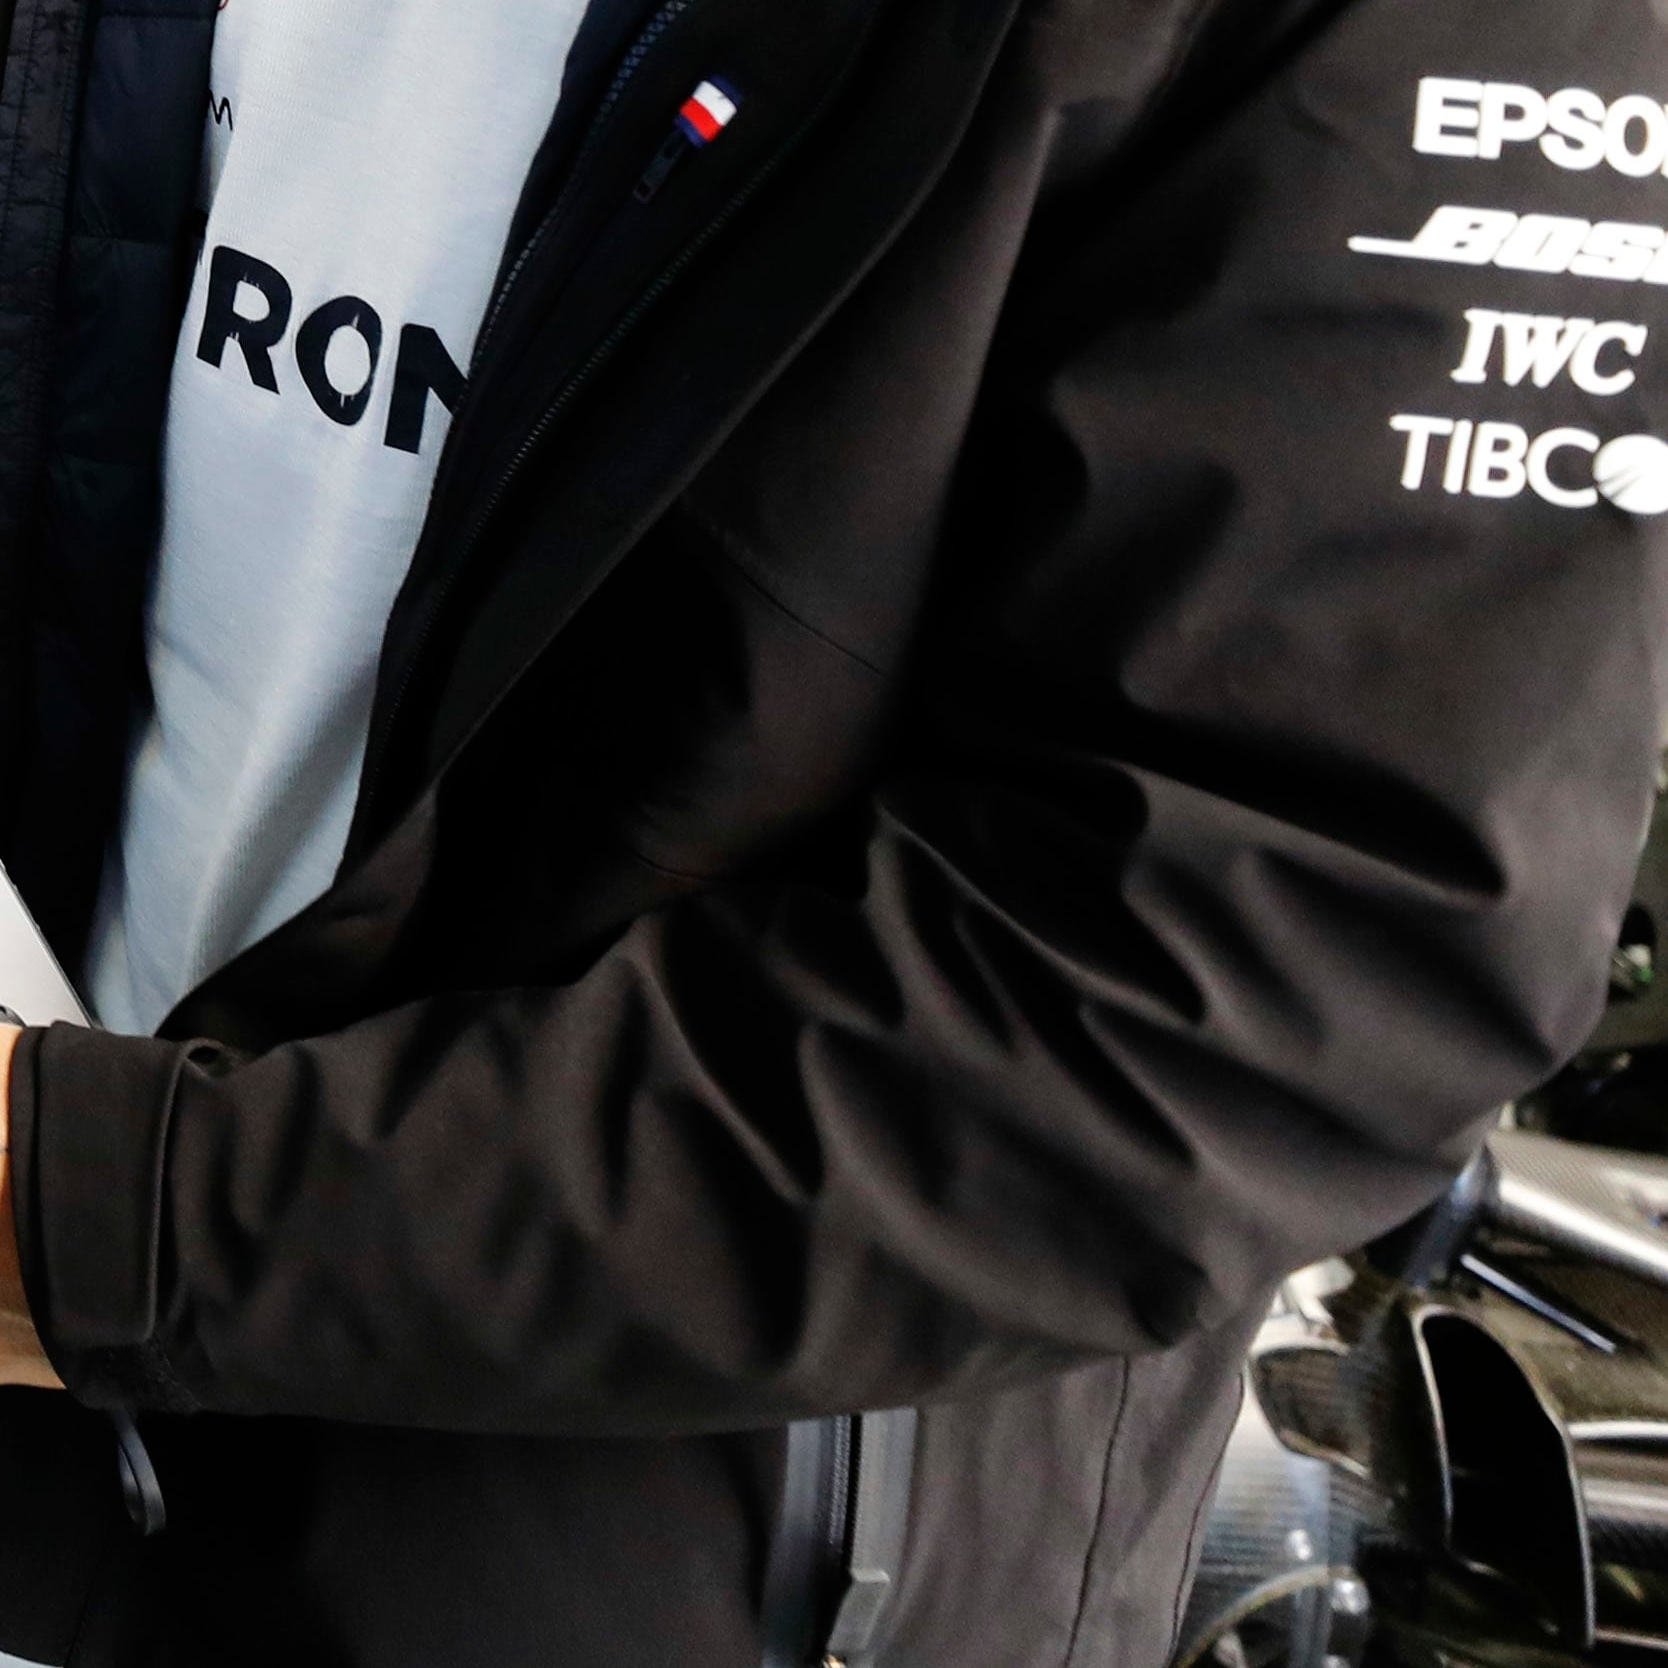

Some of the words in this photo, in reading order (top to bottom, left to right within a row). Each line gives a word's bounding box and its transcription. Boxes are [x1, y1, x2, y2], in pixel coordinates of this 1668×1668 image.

[1412, 75, 1668, 178] EPSO
[196, 244, 470, 456] RON
[1450, 307, 1648, 396] IWC
